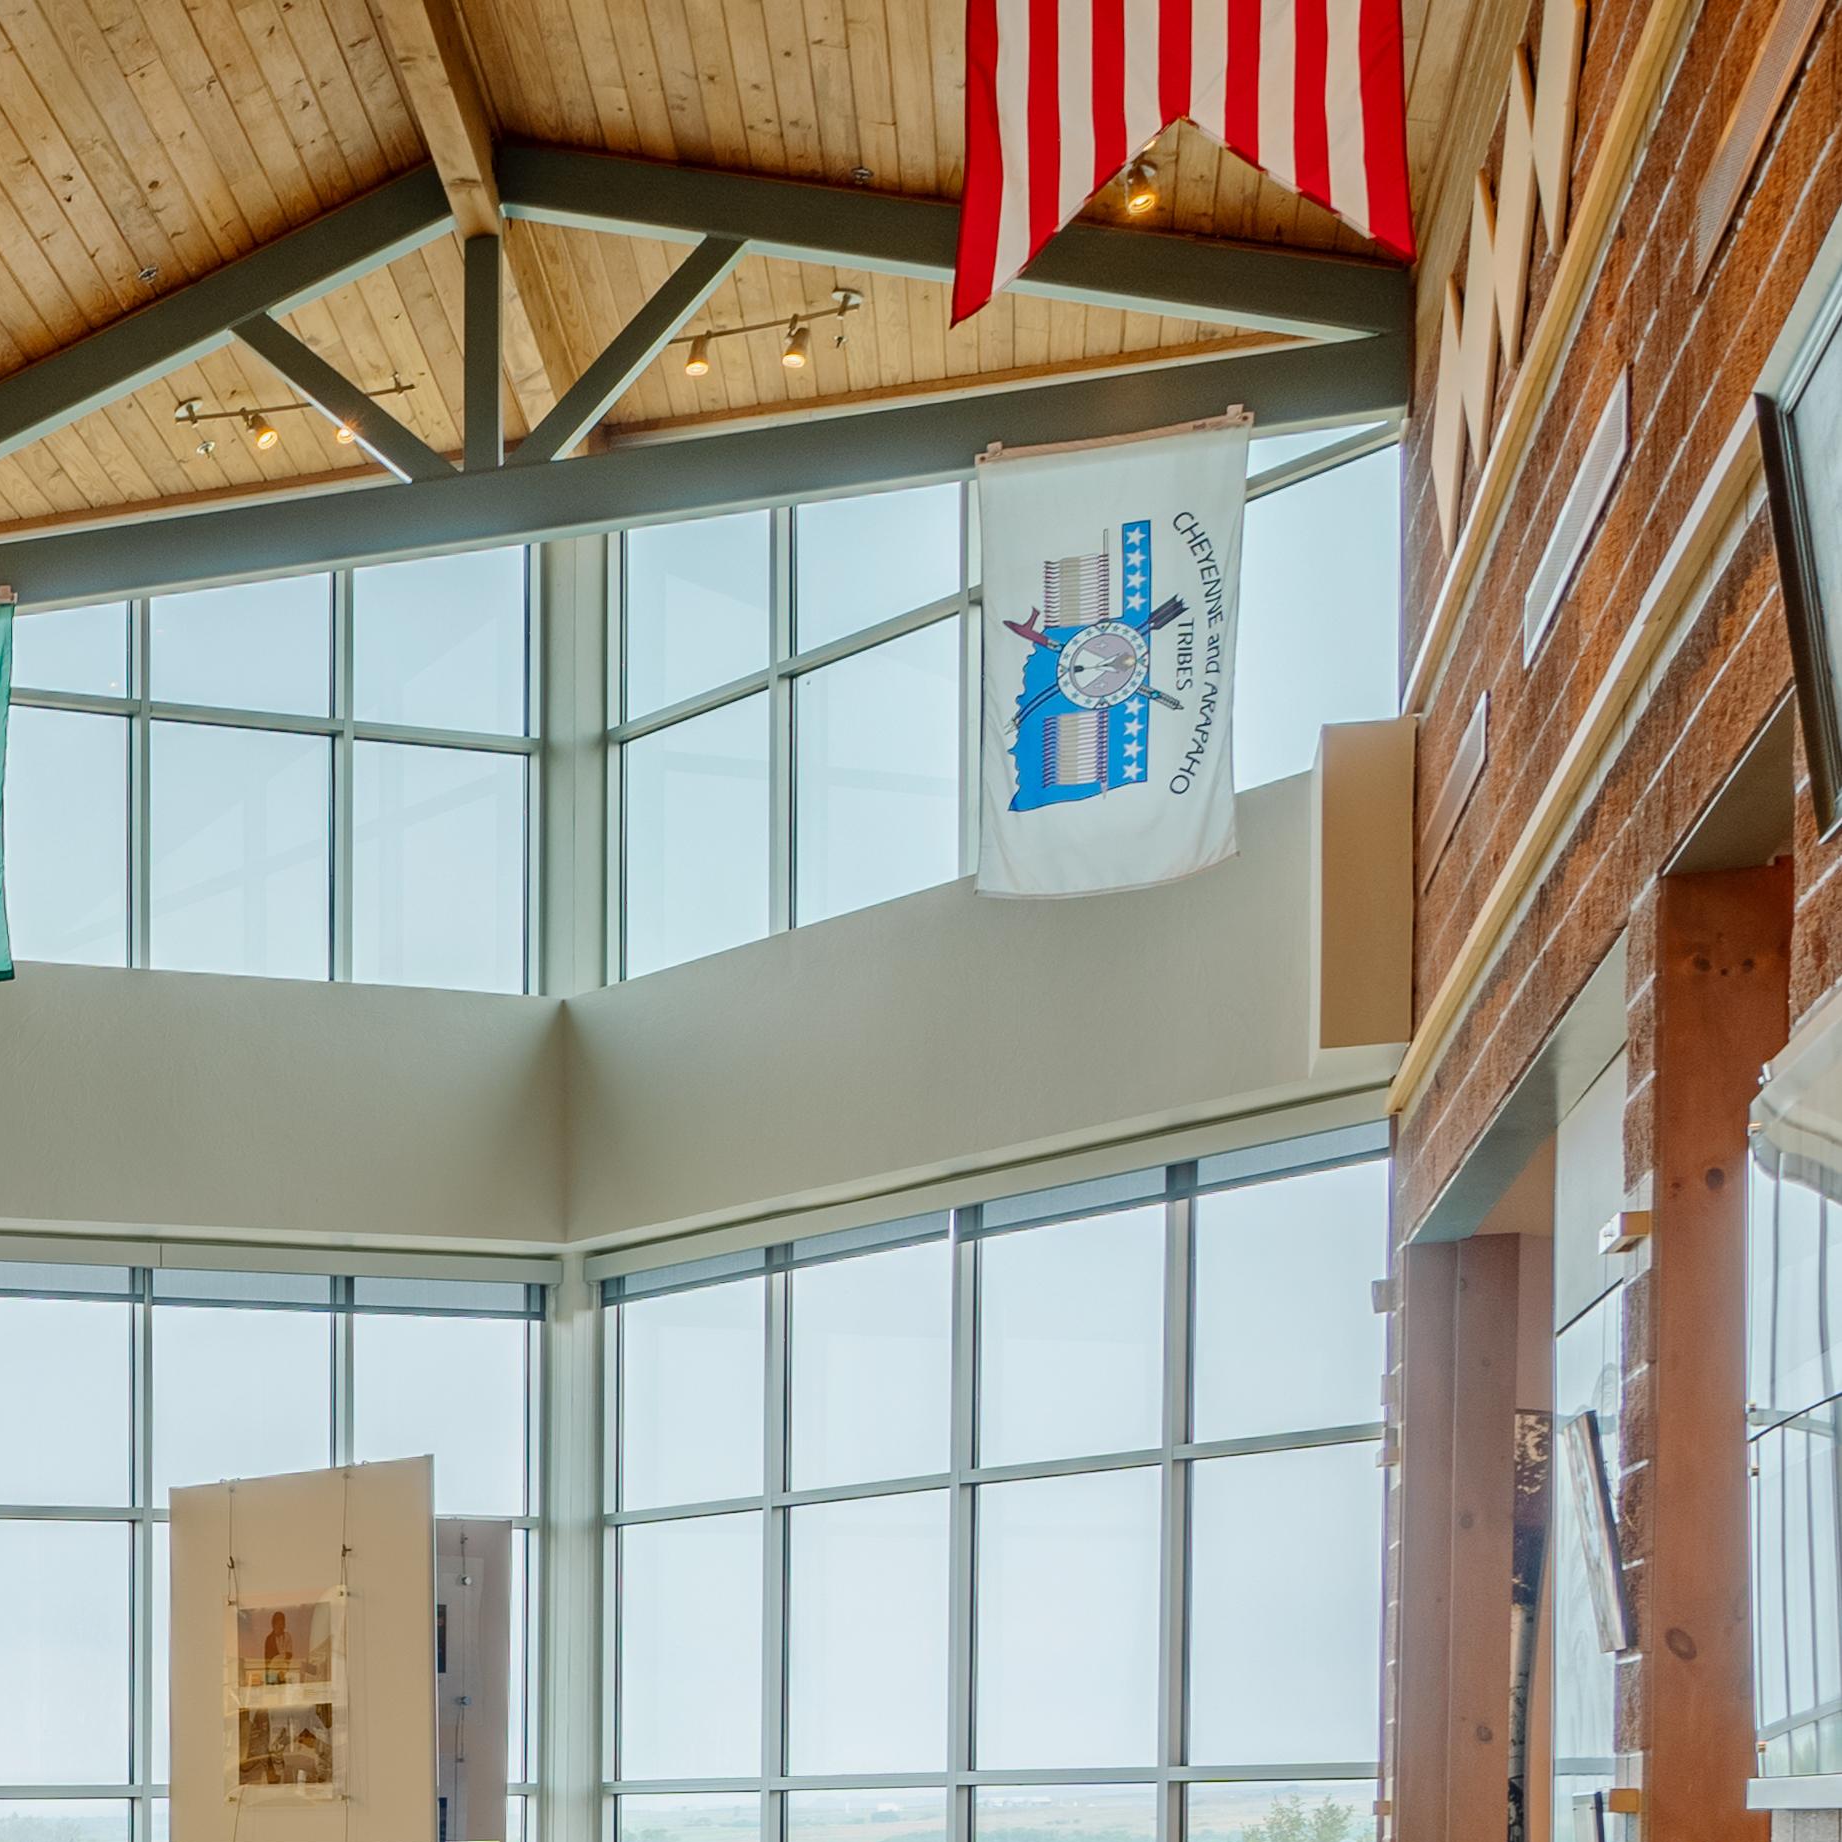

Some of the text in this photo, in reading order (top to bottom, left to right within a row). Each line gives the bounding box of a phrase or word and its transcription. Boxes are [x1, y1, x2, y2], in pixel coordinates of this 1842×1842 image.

[1169, 511, 1224, 796] CHEYENNE and ARAPAHO
[1176, 617, 1195, 692] TRIBES
